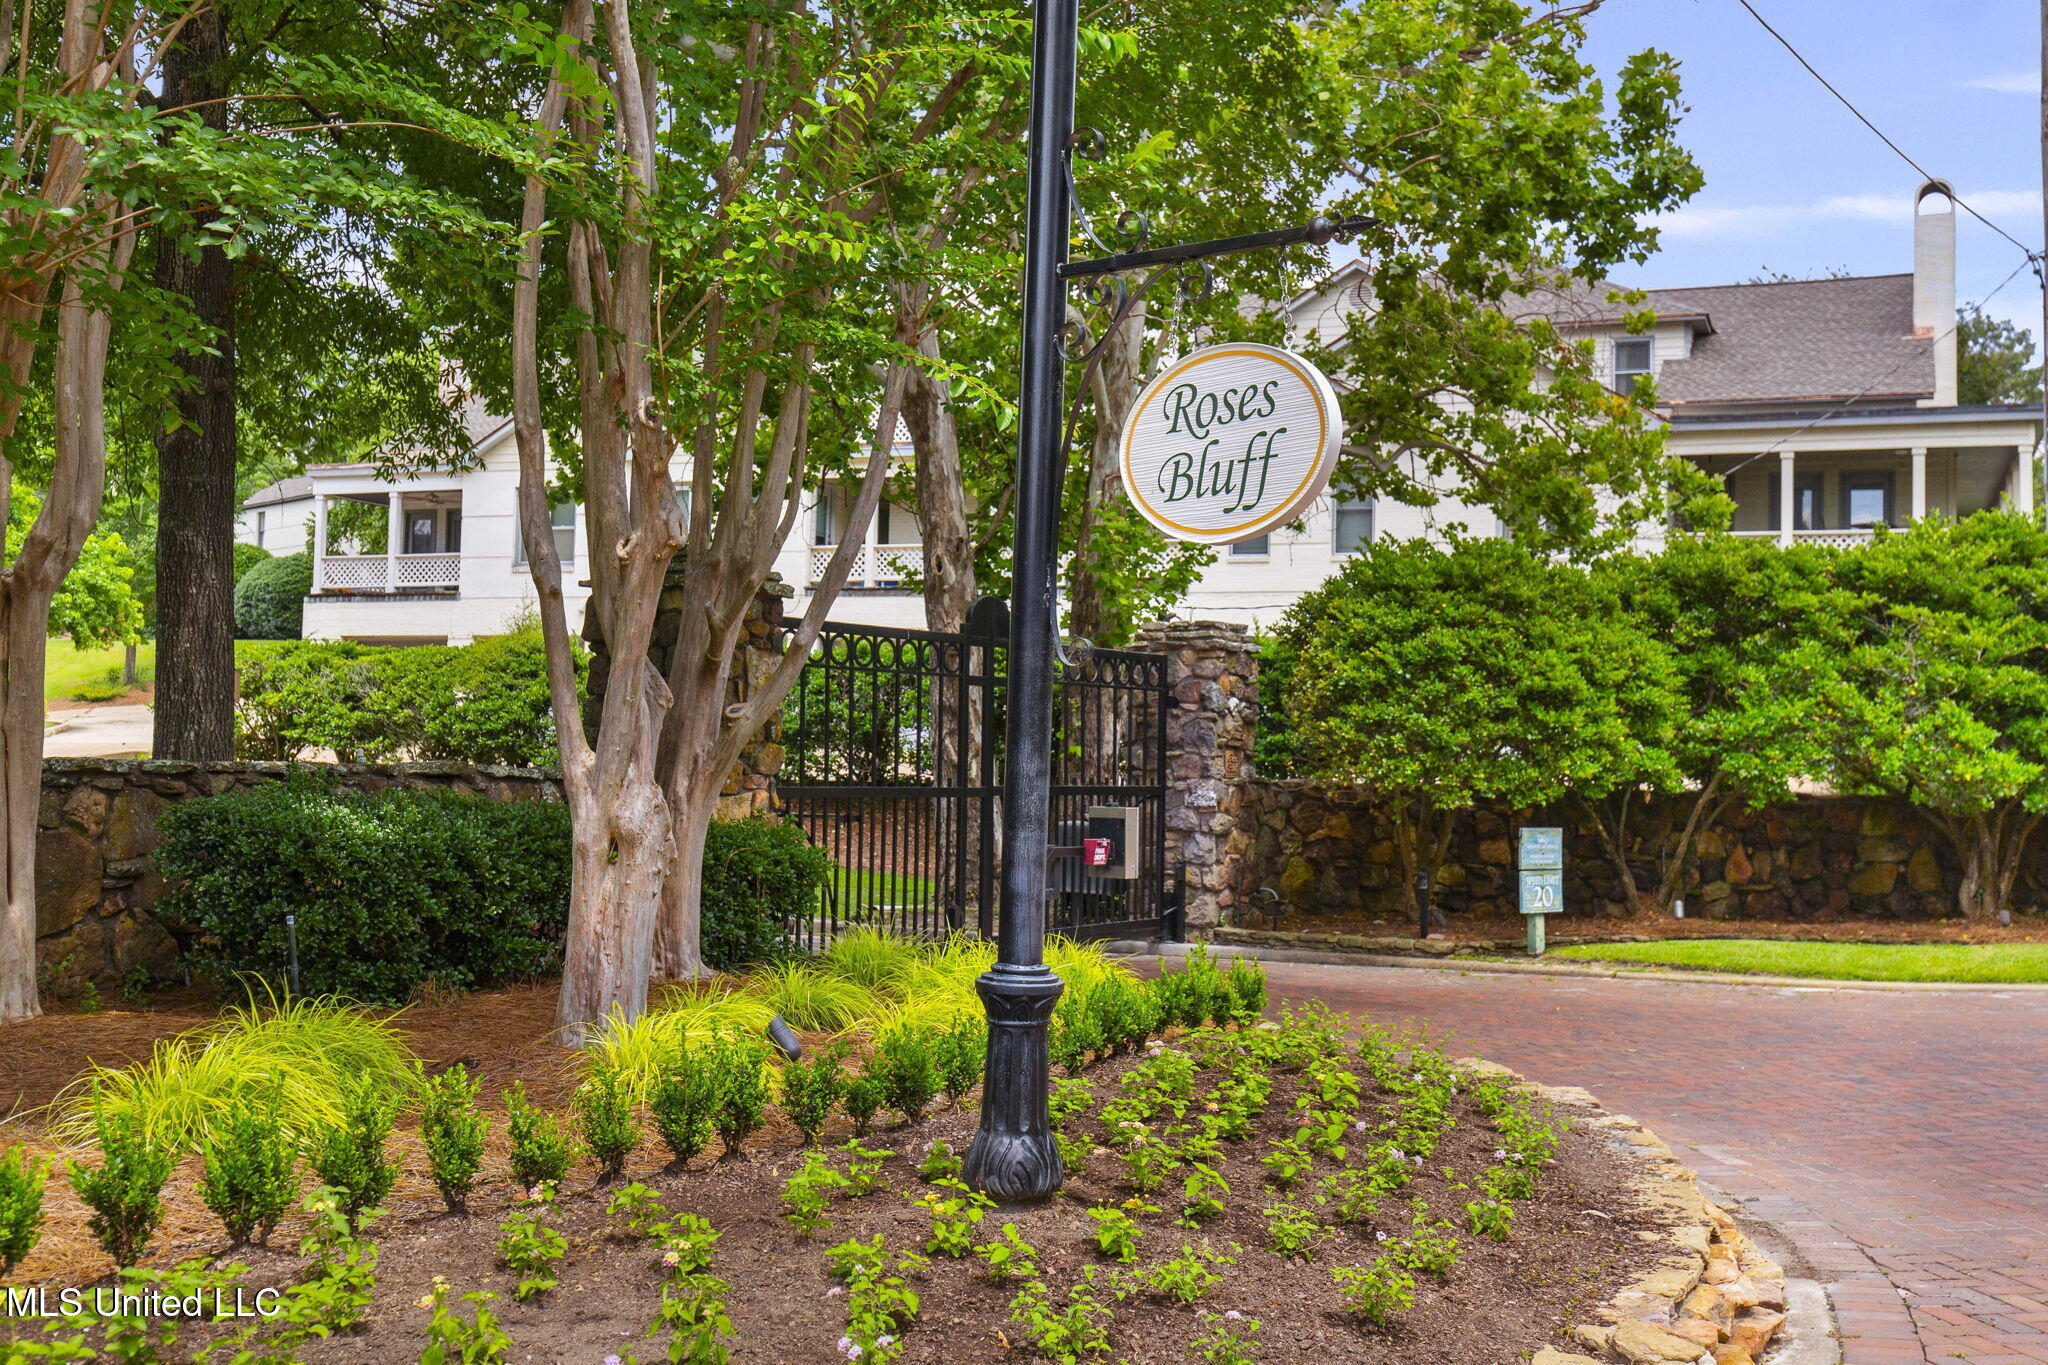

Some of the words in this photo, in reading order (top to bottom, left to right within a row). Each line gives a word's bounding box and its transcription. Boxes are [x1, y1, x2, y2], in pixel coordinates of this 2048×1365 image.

[1163, 380, 1279, 440] Roses
[1157, 427, 1288, 514] Bluff
[1526, 875, 1544, 885] SPEED
[1533, 886, 1553, 907] 20
